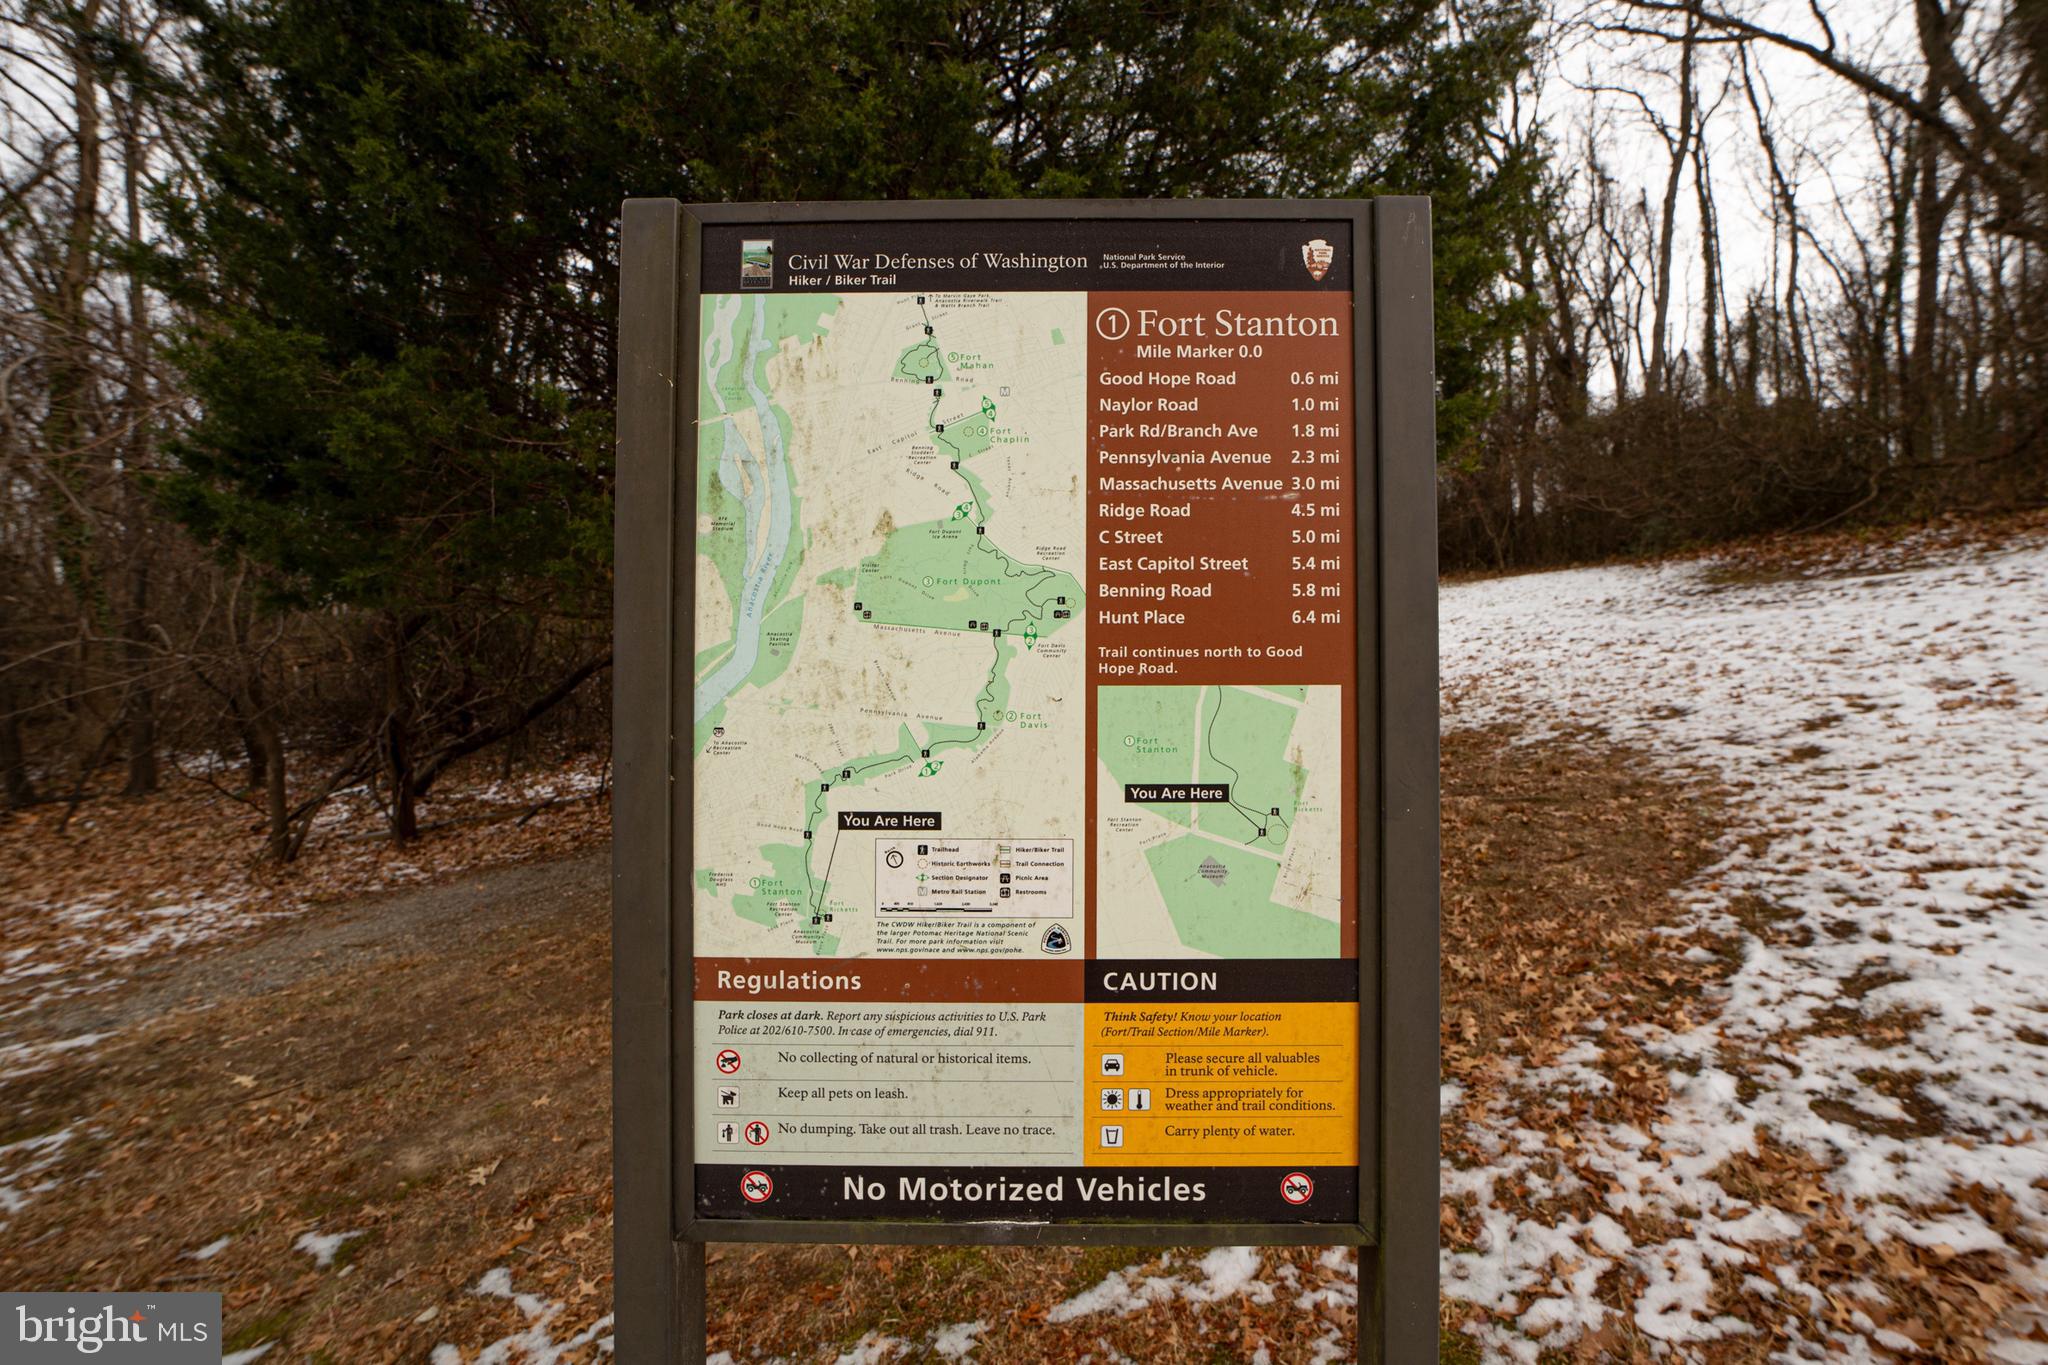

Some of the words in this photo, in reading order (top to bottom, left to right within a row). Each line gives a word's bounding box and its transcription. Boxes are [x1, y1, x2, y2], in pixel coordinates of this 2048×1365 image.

[789, 254, 828, 270] Civil
[834, 254, 870, 269] War
[875, 253, 954, 269] Defenses
[960, 253, 979, 268] of
[983, 253, 1087, 272] Washington
[1121, 262, 1167, 270] Department
[789, 275, 822, 285] Hiker
[826, 275, 831, 285] /
[835, 275, 866, 285] Biker
[870, 274, 896, 285] Trail
[1108, 314, 1116, 334] 1
[1137, 310, 1205, 336] Fort
[1216, 310, 1339, 336] Stanton
[1137, 345, 1171, 358] Mile
[1177, 344, 1234, 358] Marker
[1239, 345, 1262, 358] 0.0
[1100, 371, 1142, 385] Good
[1149, 372, 1190, 388] Hope
[1196, 371, 1236, 385] Road
[1291, 372, 1314, 385] 0.6
[1320, 371, 1338, 384] mi
[990, 427, 1011, 435] Fort
[1100, 424, 1134, 437] Park
[1140, 424, 1221, 437] Rd/Branch
[1227, 424, 1257, 437] Ave
[1292, 424, 1314, 437] 1.8
[1320, 424, 1339, 437] mi
[990, 436, 1029, 445] Chaplin
[1100, 450, 1204, 467] Pennsylvania
[1210, 451, 1271, 463] Avenue
[1292, 450, 1314, 463] 2.3
[1320, 450, 1339, 463] mi
[1100, 476, 1216, 490] Massachusetts
[1222, 477, 1283, 490] Avenue
[1292, 477, 1315, 490] 3.0
[1321, 476, 1339, 490] mi
[1099, 530, 1109, 544] C
[1115, 530, 1163, 543] Street
[1293, 530, 1315, 543] 5.0
[1321, 529, 1340, 543] mi
[963, 578, 1001, 586] Dupont
[1100, 611, 1139, 624] Hunt
[1144, 610, 1185, 624] Place
[1292, 610, 1316, 623] 6.4
[1321, 610, 1340, 623] mi
[1098, 646, 1127, 657] Trail
[1133, 646, 1199, 657] continues
[1205, 646, 1242, 657] north
[1247, 648, 1261, 657] to
[1266, 646, 1302, 657] Good
[1099, 663, 1134, 676] Hope
[1138, 662, 1177, 675] Road.
[1137, 737, 1157, 745] Fort
[1136, 745, 1177, 753] Stanton
[1131, 788, 1156, 799] You
[1161, 788, 1185, 799] Are
[1191, 788, 1222, 799] Here
[844, 814, 869, 826] You
[874, 815, 898, 826] Are
[903, 815, 935, 826] Here
[761, 879, 783, 887] Fort
[762, 888, 802, 896] Stanton
[718, 970, 861, 994] Regulations
[1104, 972, 1216, 990] CAUTION
[718, 1010, 744, 1019] Park
[747, 1010, 778, 1020] closes
[781, 1012, 792, 1020] at
[794, 1010, 823, 1020] dark.
[827, 1011, 861, 1023] Report
[863, 1014, 883, 1023] any
[885, 1010, 936, 1023] suspicious
[938, 1012, 983, 1021] activities
[986, 1013, 996, 1021] to
[999, 1011, 1018, 1021] U.S.
[1022, 1012, 1046, 1021] Park
[1104, 1011, 1136, 1022] Think
[1139, 1012, 1177, 1024] Safety!
[1180, 1012, 1211, 1021] Know
[1212, 1014, 1238, 1024] your
[1239, 1012, 1281, 1021] location
[1101, 1026, 1155, 1037] (Fort/Trail
[1157, 1026, 1220, 1038] Section/Mile
[1223, 1027, 1268, 1038] Marker).
[778, 1052, 796, 1062] No
[800, 1052, 858, 1066] collecting
[861, 1052, 874, 1063] of
[877, 1052, 918, 1063] natural
[938, 1052, 992, 1064] historical
[996, 1053, 1031, 1064] items.
[1166, 1052, 1203, 1064] Please
[1206, 1056, 1246, 1064] secure
[1248, 1052, 1263, 1063] all
[1265, 1052, 1320, 1063] valuables
[778, 1087, 808, 1101] Keep
[811, 1087, 825, 1098] all
[829, 1090, 853, 1101] pets
[875, 1088, 908, 1099] leash.
[1165, 1088, 1199, 1099] Dress
[1203, 1087, 1283, 1101] appropriately
[1286, 1087, 1303, 1098] for
[778, 1122, 797, 1134] No
[800, 1123, 856, 1137] dumping.
[859, 1123, 886, 1134] Take
[889, 1126, 909, 1134] out
[912, 1124, 926, 1134] all
[930, 1124, 962, 1135] trash.
[966, 1124, 1000, 1135] Leave
[1004, 1127, 1019, 1135] no
[1022, 1126, 1055, 1135] trace.
[844, 1175, 885, 1200] No
[900, 1176, 1062, 1201] Motorized
[1076, 1176, 1207, 1201] Vehicles
